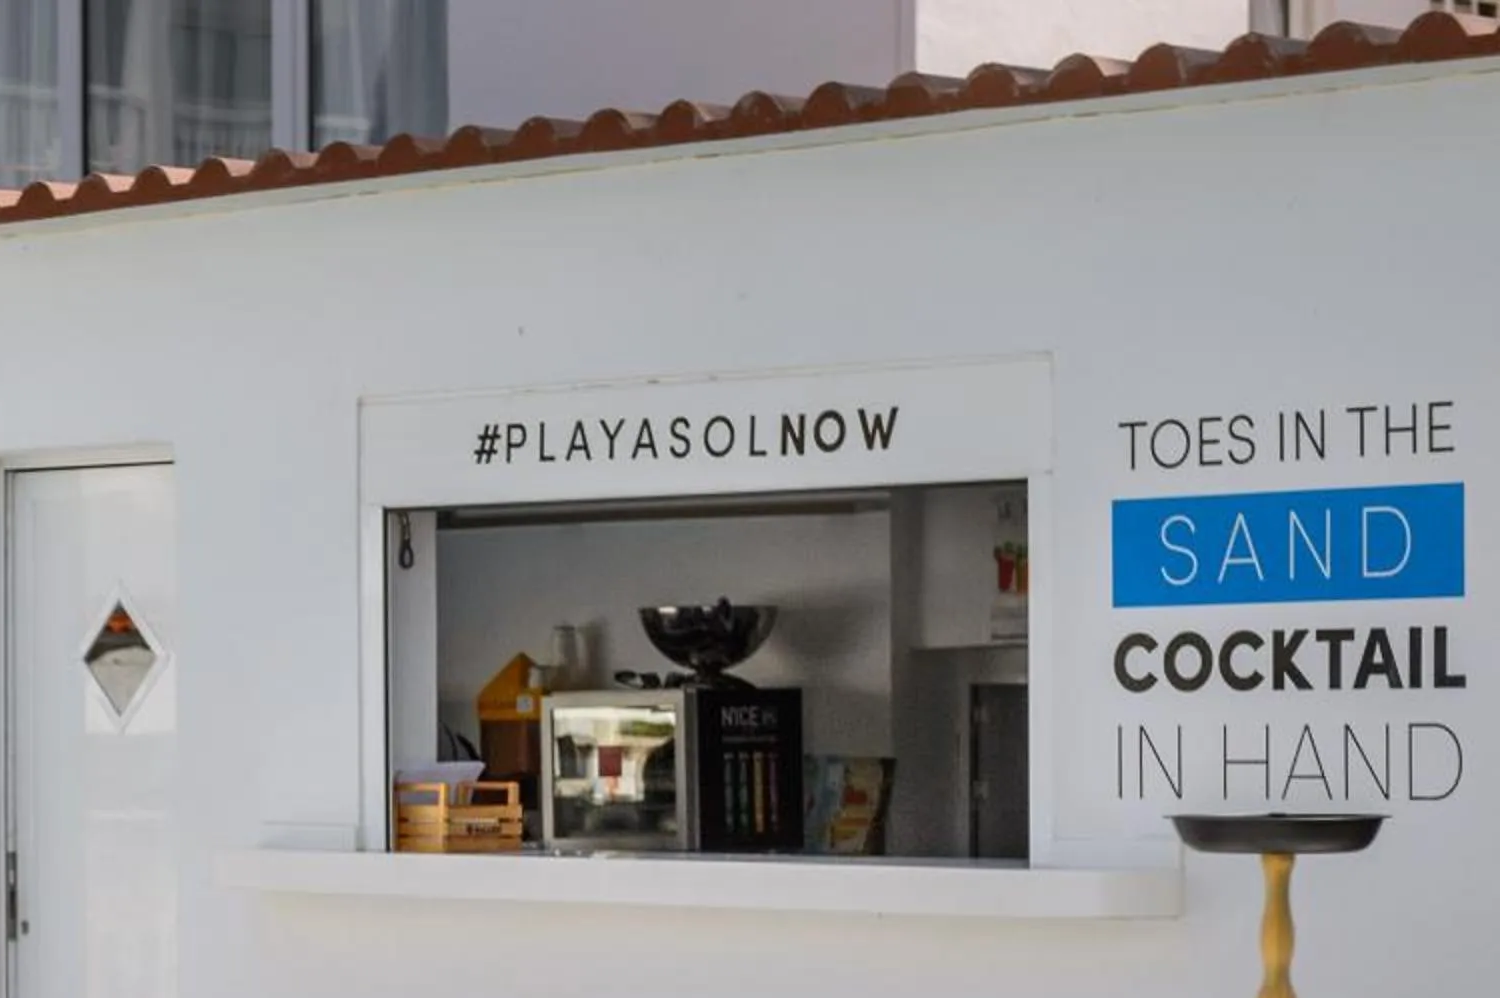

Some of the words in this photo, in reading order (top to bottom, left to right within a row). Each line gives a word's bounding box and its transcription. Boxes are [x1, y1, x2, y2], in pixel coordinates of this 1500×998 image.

[474, 407, 899, 464] #PLAYASOLNOW
[1118, 414, 1256, 470] TOES
[1280, 409, 1325, 462] IN
[1346, 401, 1455, 457] THE
[1160, 506, 1412, 585] SAND
[1113, 626, 1467, 693] COCKTAIL
[1117, 725, 1182, 800] IN
[1222, 723, 1463, 801] HAND
